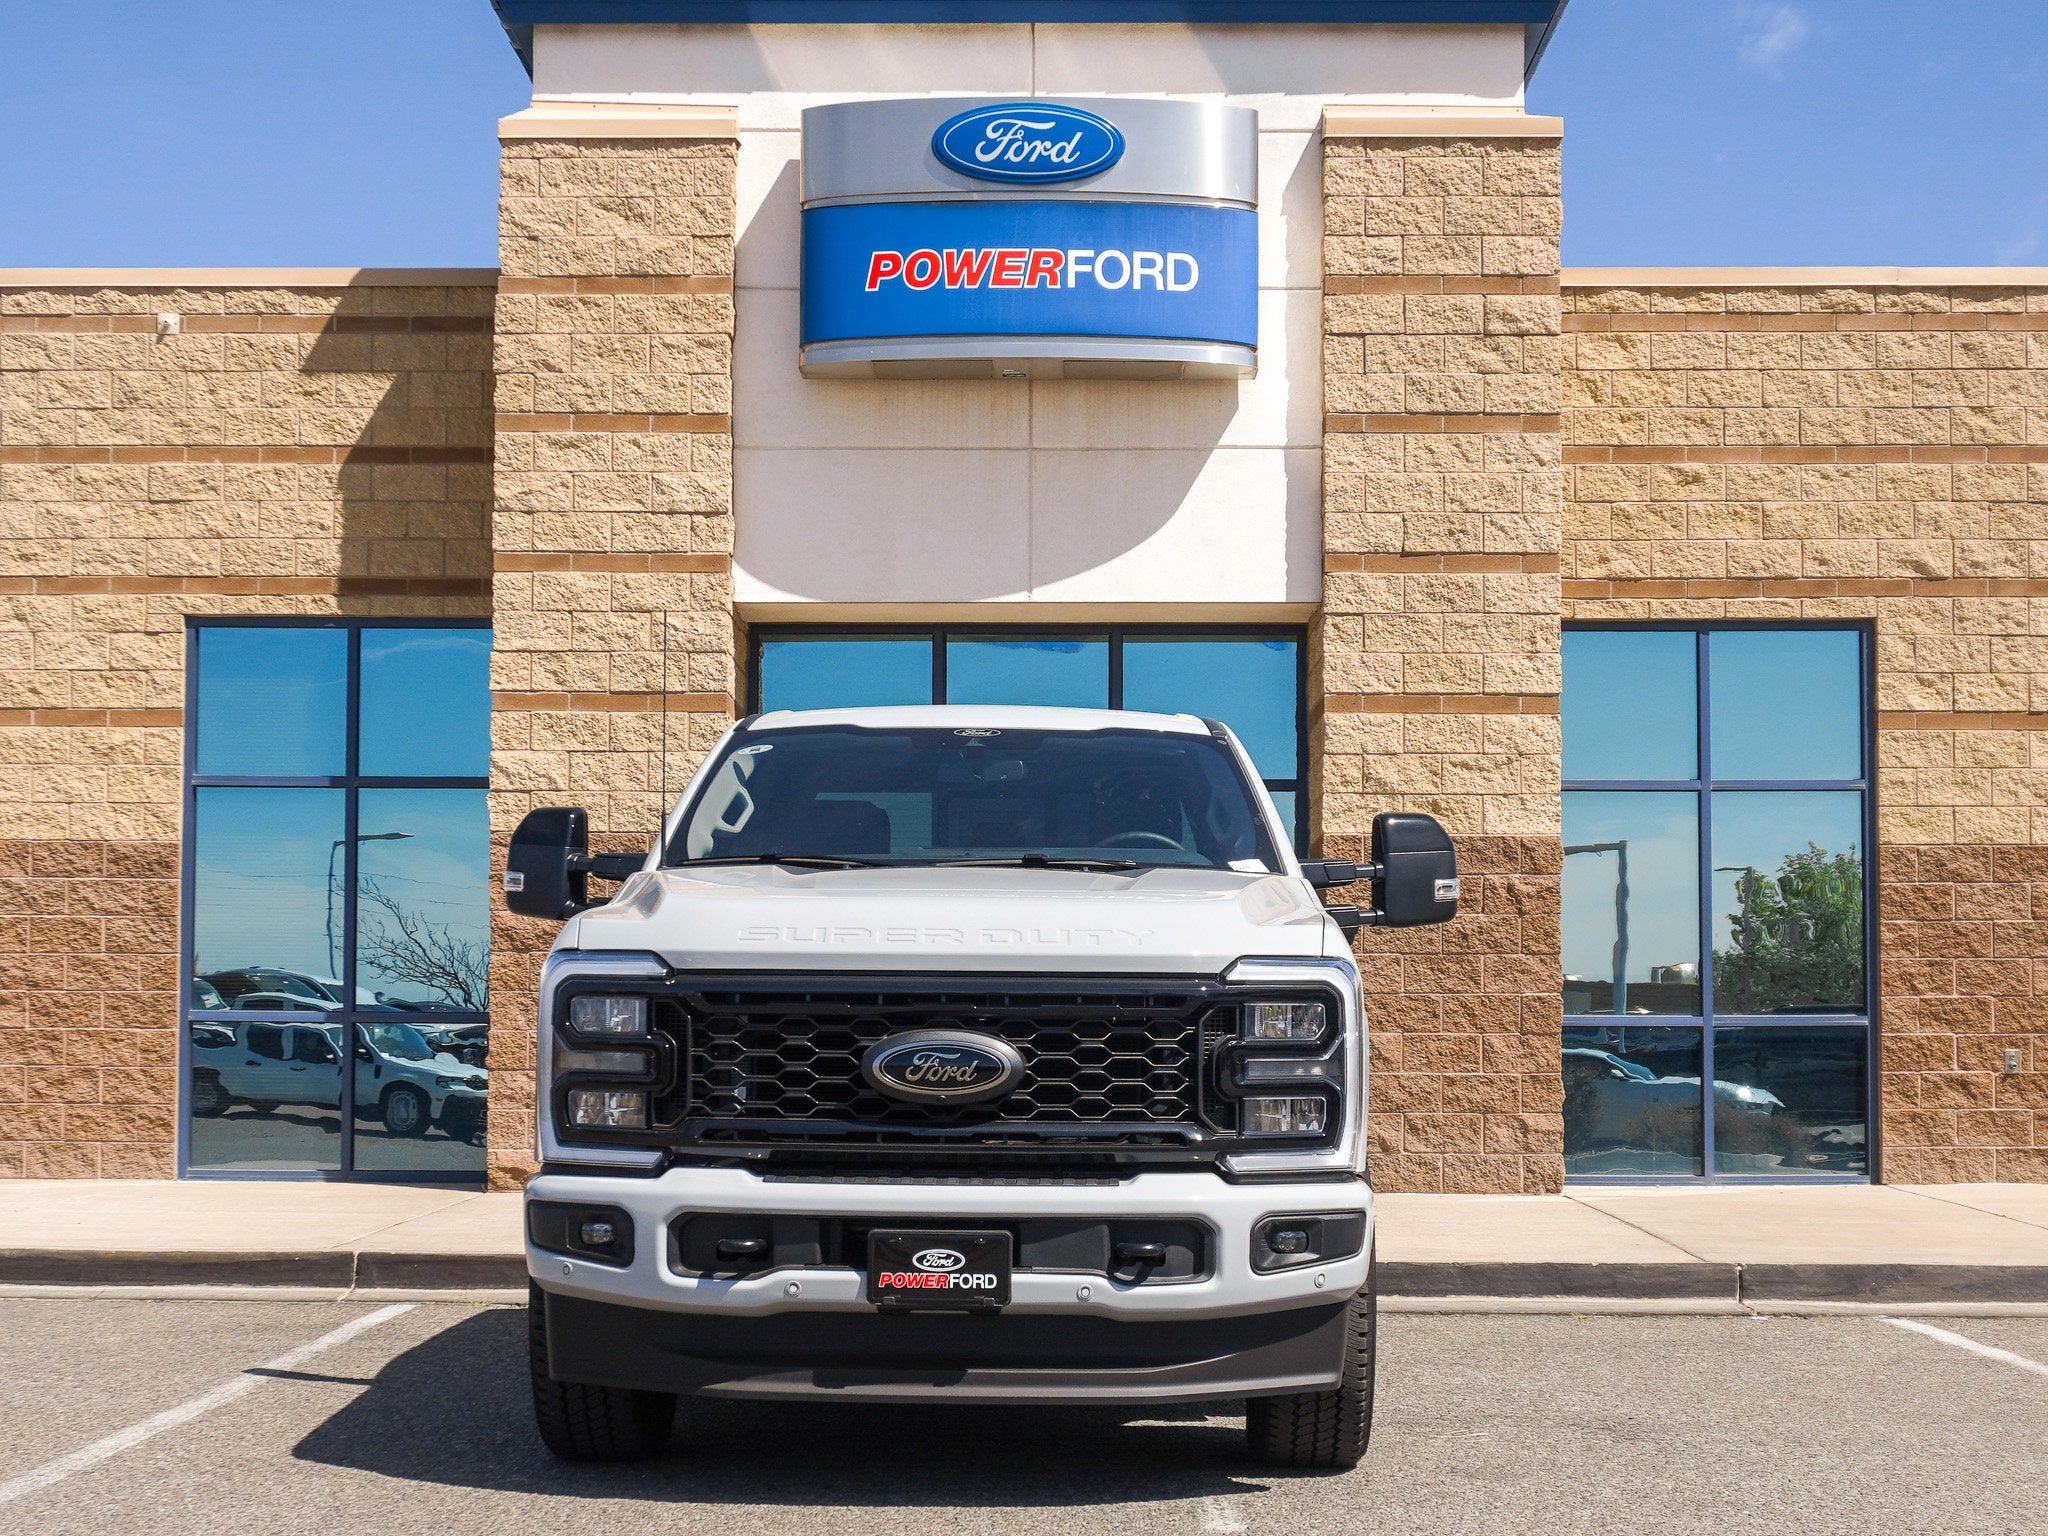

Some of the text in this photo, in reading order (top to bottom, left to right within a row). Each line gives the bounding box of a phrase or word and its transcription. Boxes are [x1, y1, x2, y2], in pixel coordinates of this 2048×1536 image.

[974, 118, 1082, 164] Ford
[736, 926, 1154, 946] SUPER DUTY
[905, 1051, 979, 1082] Ford
[922, 1253, 955, 1267] Ford
